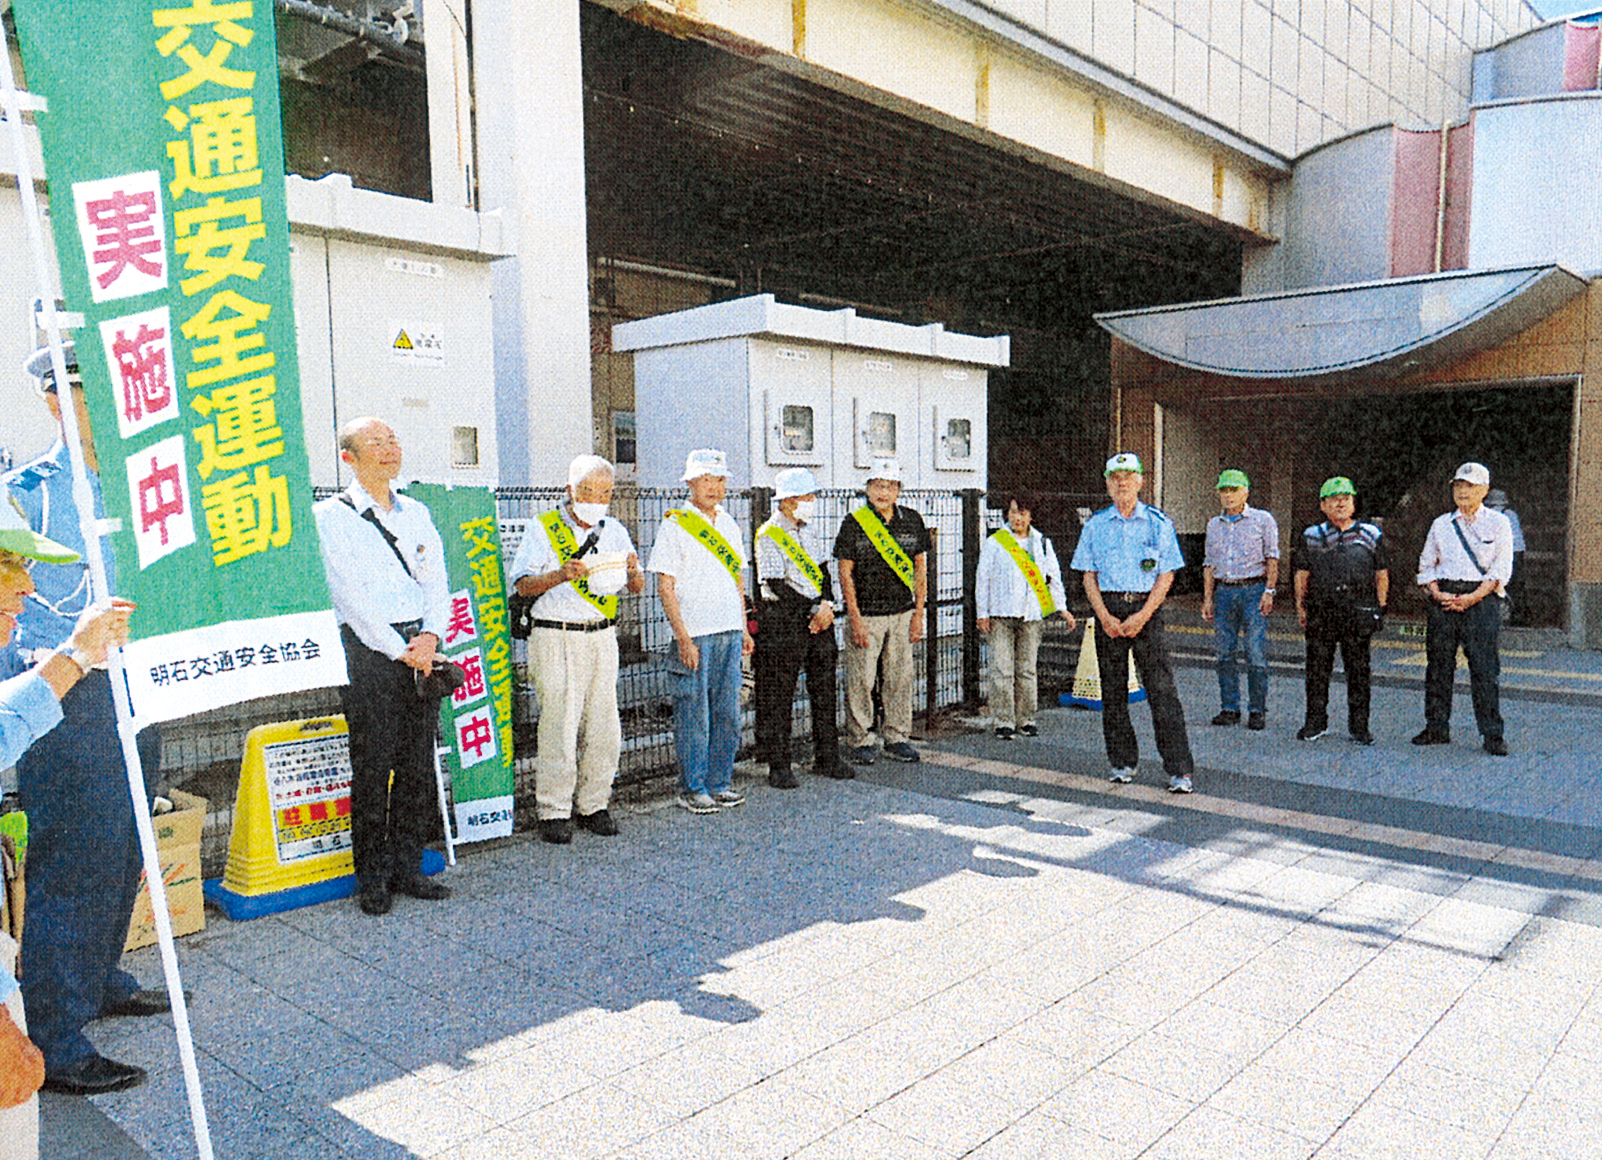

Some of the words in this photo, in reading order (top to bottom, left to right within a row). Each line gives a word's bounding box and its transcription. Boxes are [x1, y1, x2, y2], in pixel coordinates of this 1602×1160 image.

[86, 190, 184, 546] 実施中
[153, 0, 293, 567] 交通安全運動
[150, 638, 321, 687] 明石交通安全協会
